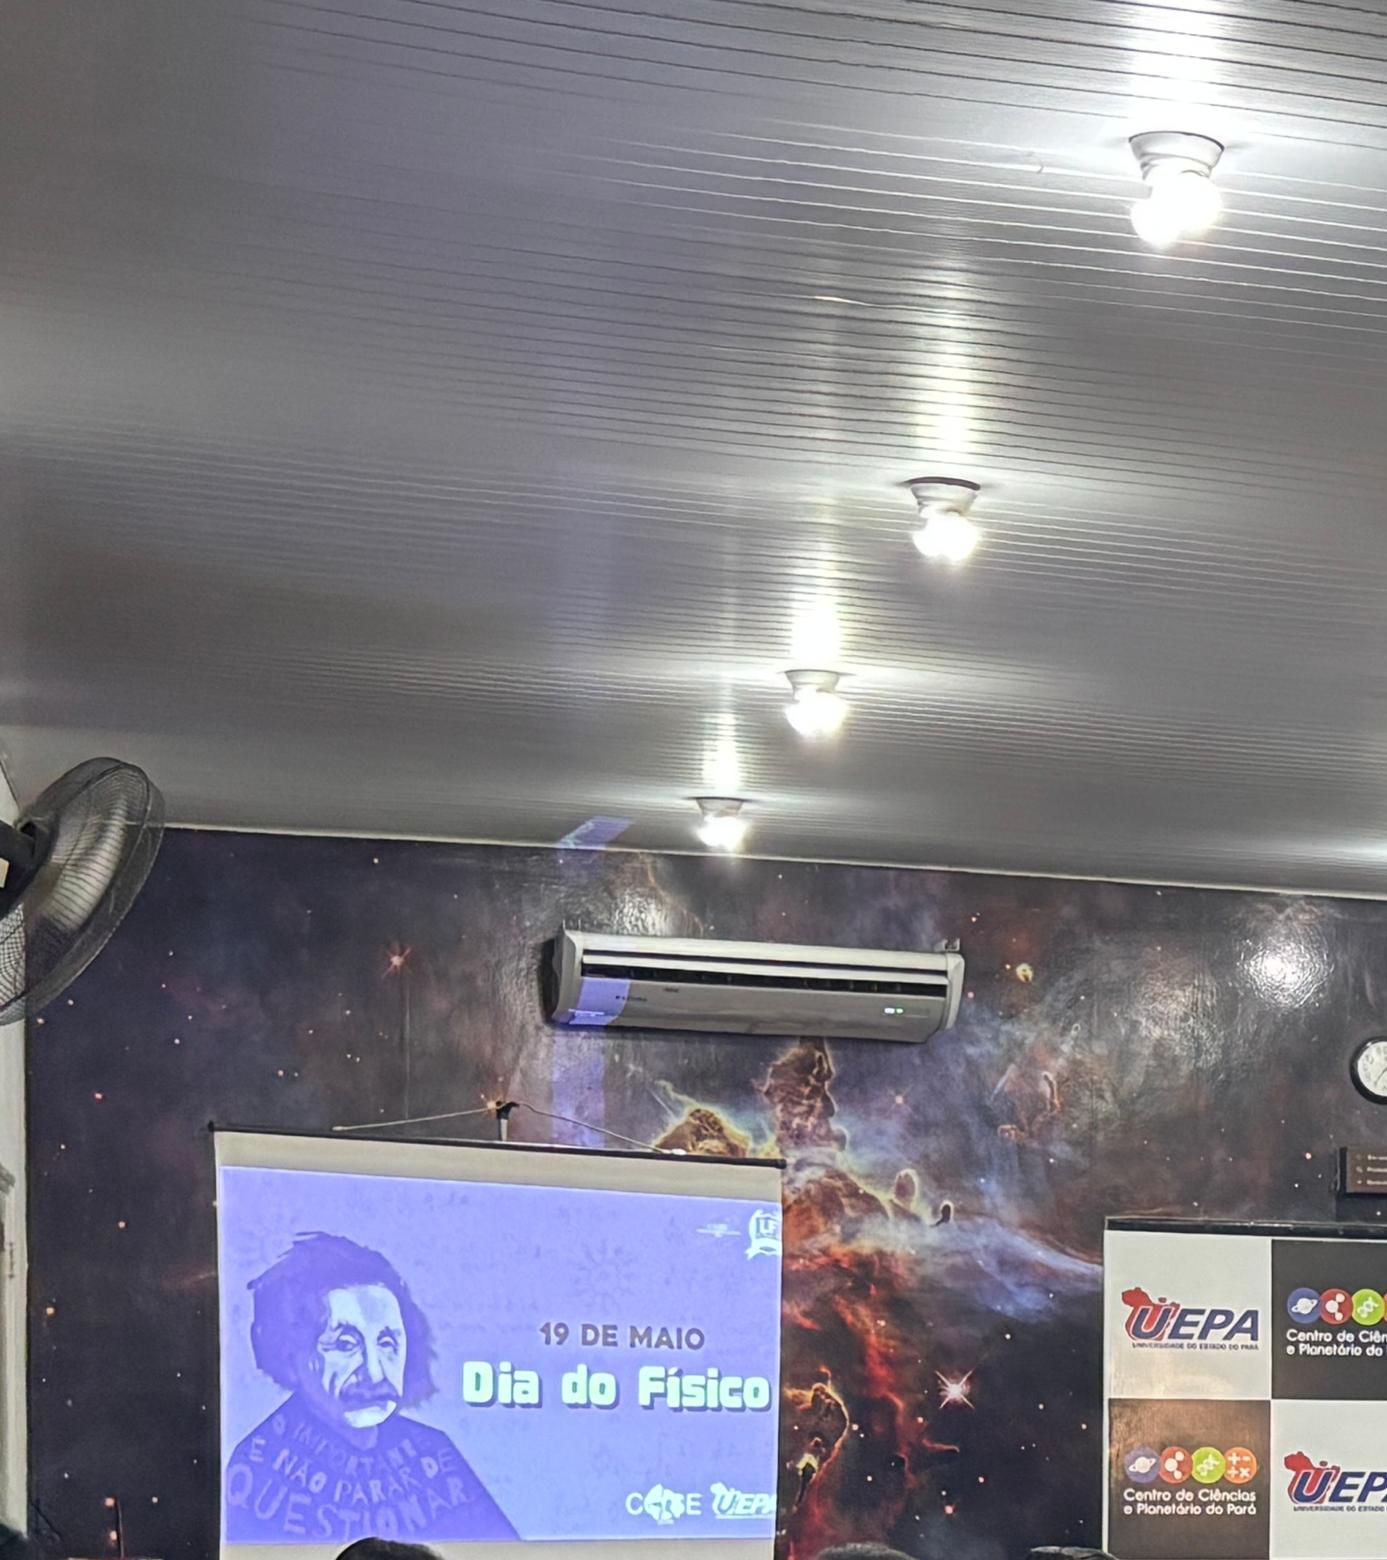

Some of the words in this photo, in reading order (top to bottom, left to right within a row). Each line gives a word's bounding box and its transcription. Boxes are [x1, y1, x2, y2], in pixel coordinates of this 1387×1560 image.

[1130, 1306, 1259, 1341] UEPA
[539, 1322, 569, 1346] 19
[581, 1323, 619, 1347] DE
[629, 1325, 706, 1351] MAIO
[1286, 1329, 1332, 1341] Centro
[1337, 1330, 1353, 1342] de
[1298, 1343, 1361, 1357] Planetário
[1366, 1345, 1382, 1357] do
[462, 1361, 542, 1408] Dia
[561, 1363, 619, 1409] do
[638, 1365, 772, 1412] Físico
[1124, 1488, 1170, 1501] Centro
[1176, 1488, 1193, 1501] de
[1199, 1488, 1256, 1502] Ciências
[1124, 1505, 1132, 1515] e
[1136, 1502, 1201, 1517] Planetário
[1206, 1503, 1222, 1516] do
[1226, 1503, 1256, 1516] Pará
